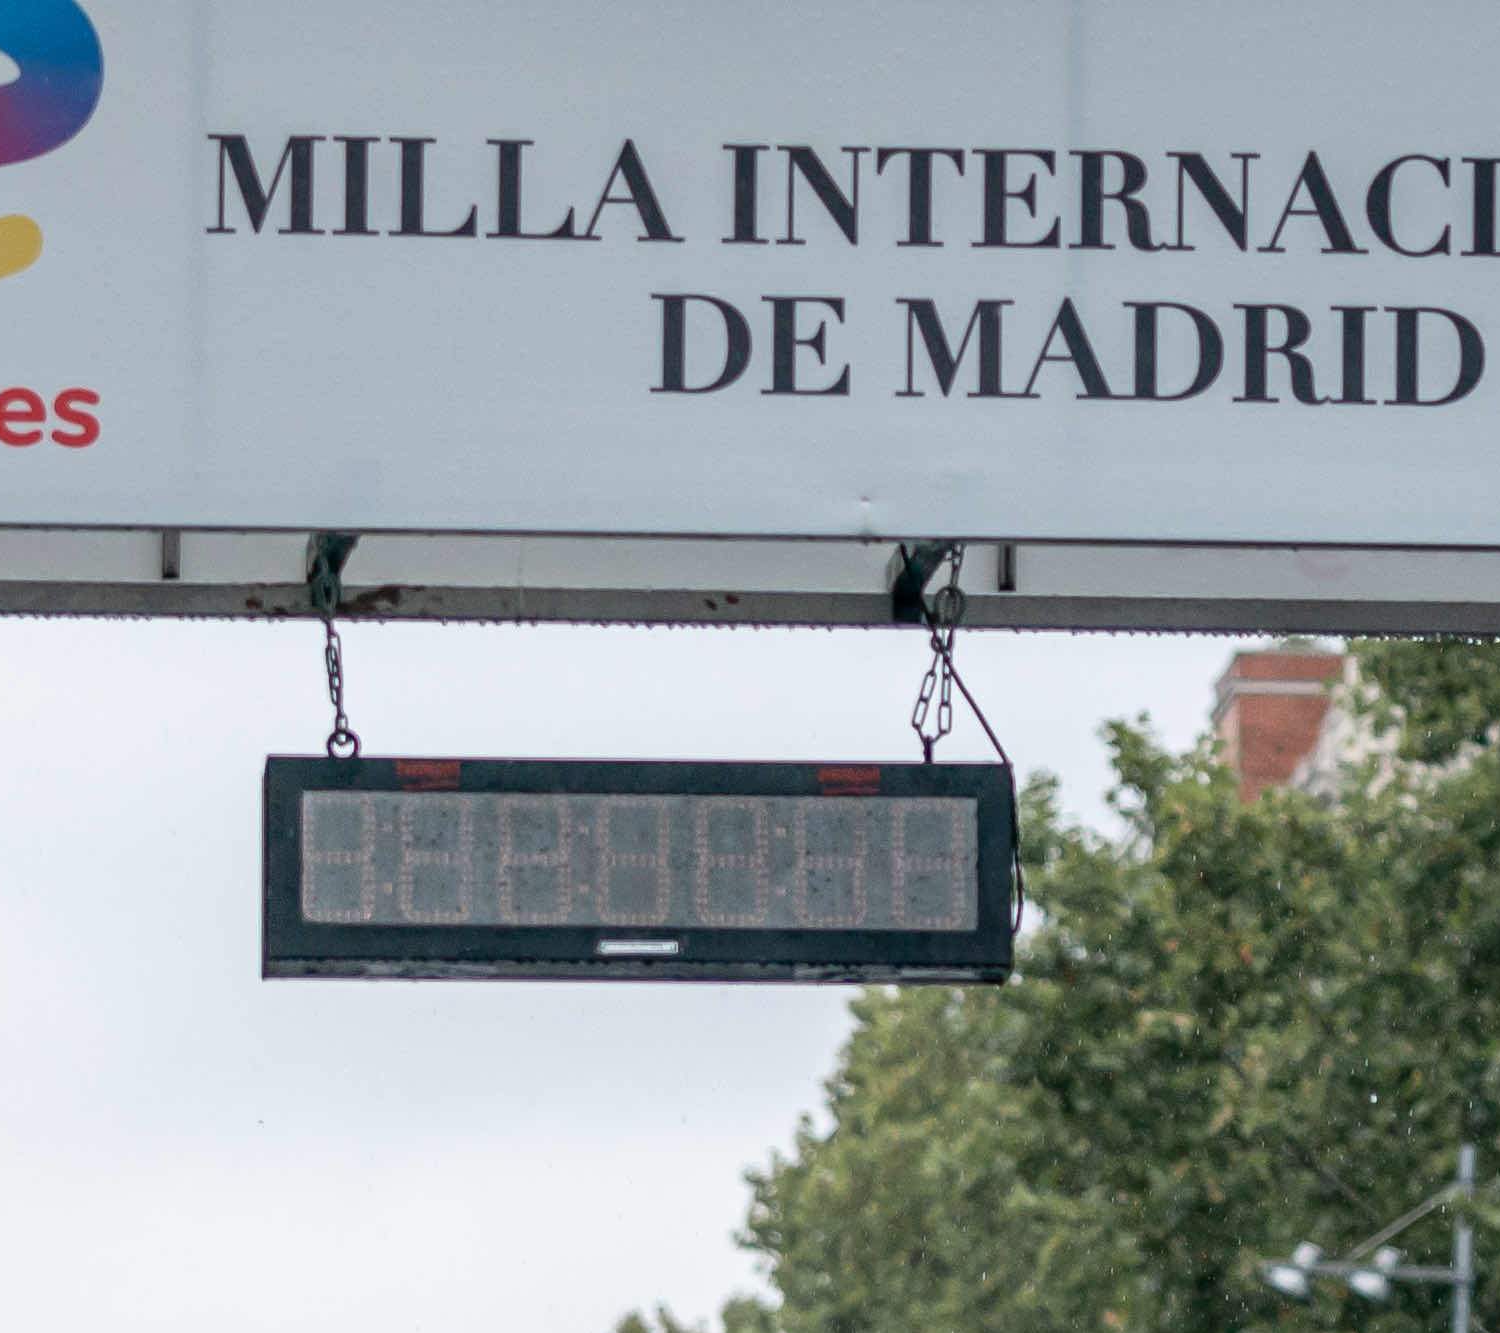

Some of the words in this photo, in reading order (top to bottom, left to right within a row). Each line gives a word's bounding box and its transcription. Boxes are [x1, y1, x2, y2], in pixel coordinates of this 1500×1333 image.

[204, 133, 684, 243] MILLA
[649, 292, 851, 398] DE
[893, 299, 1486, 406] MADRID
